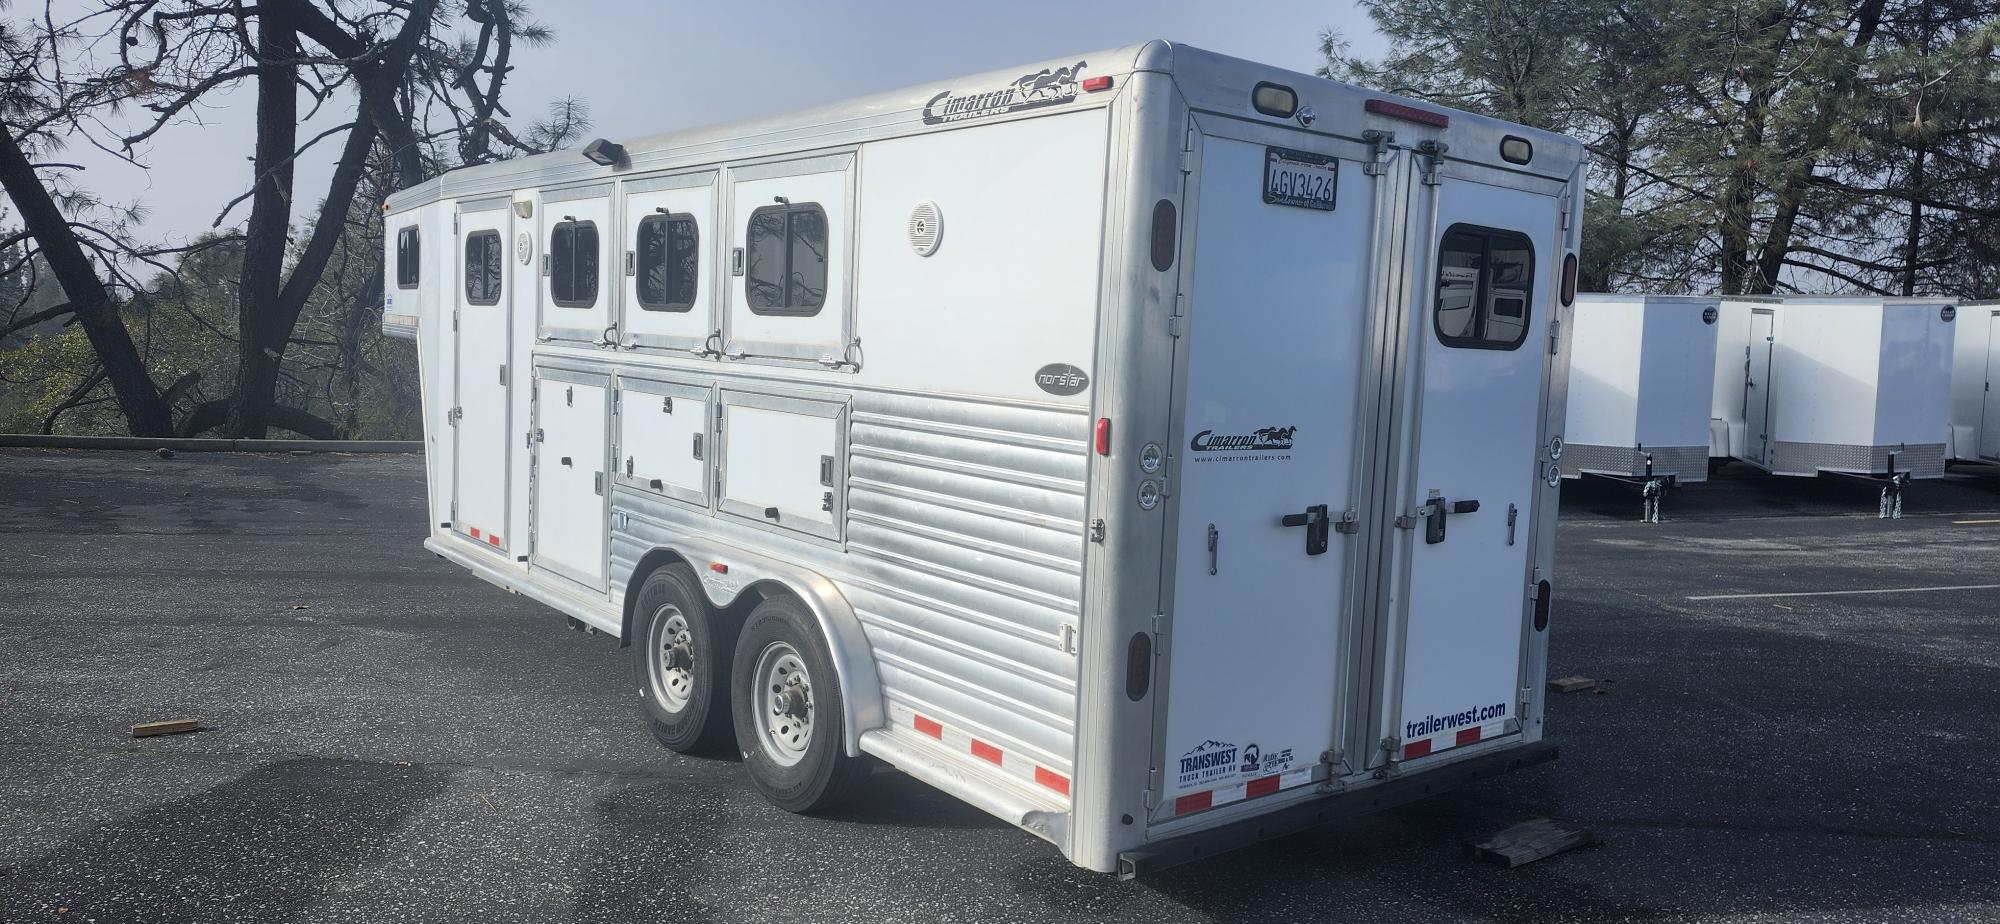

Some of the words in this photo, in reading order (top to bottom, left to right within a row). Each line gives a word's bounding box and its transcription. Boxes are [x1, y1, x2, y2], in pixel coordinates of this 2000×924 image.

[923, 90, 1015, 125] Cimarron
[942, 106, 1010, 122] TRAILERS
[1271, 169, 1332, 200] 4GV3426
[1038, 367, 1086, 388] norstar
[1191, 430, 1257, 451] Cimarron
[1406, 702, 1506, 738] trailerwest.com
[1180, 748, 1237, 773] TRANSWEST
[1180, 773, 1199, 783] TRUCK
[1202, 767, 1226, 778] TRAILER
